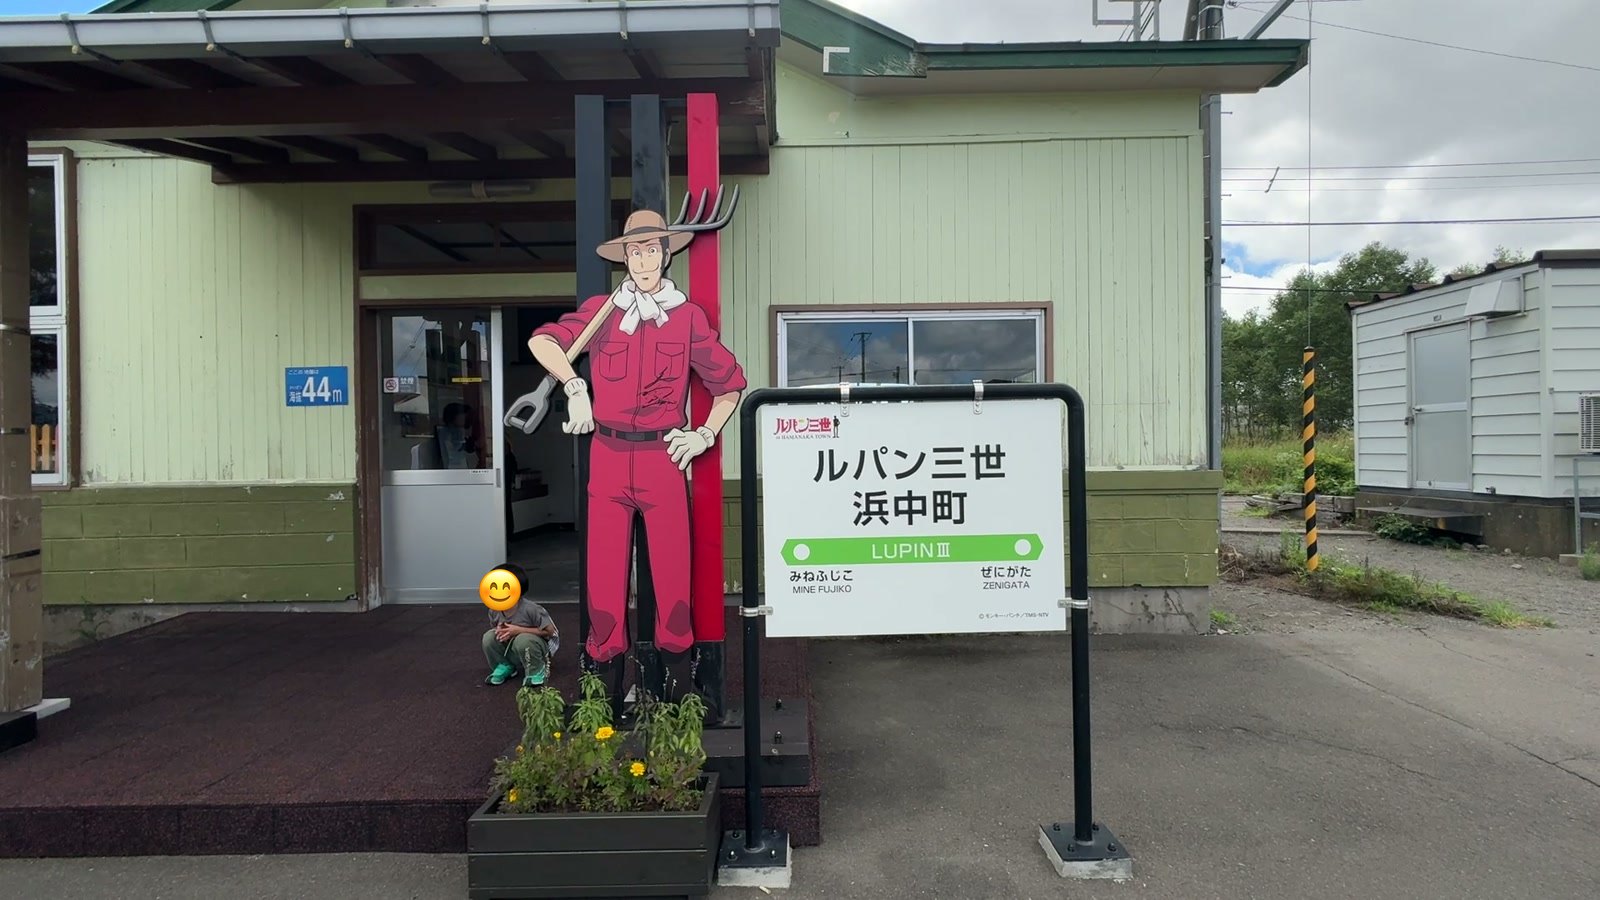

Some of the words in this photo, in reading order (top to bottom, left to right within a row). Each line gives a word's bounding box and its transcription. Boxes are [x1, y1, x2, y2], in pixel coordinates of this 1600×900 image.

[773, 417, 831, 435] ルパン三世
[813, 444, 1006, 482] ルパン三世
[853, 490, 967, 526] 浜中町
[789, 570, 853, 582] みねふじこ
[980, 566, 1031, 578] ぜにがた
[793, 585, 816, 594] MINE
[818, 585, 852, 593] FUJIKO
[983, 581, 1030, 590] ZENIGATA
